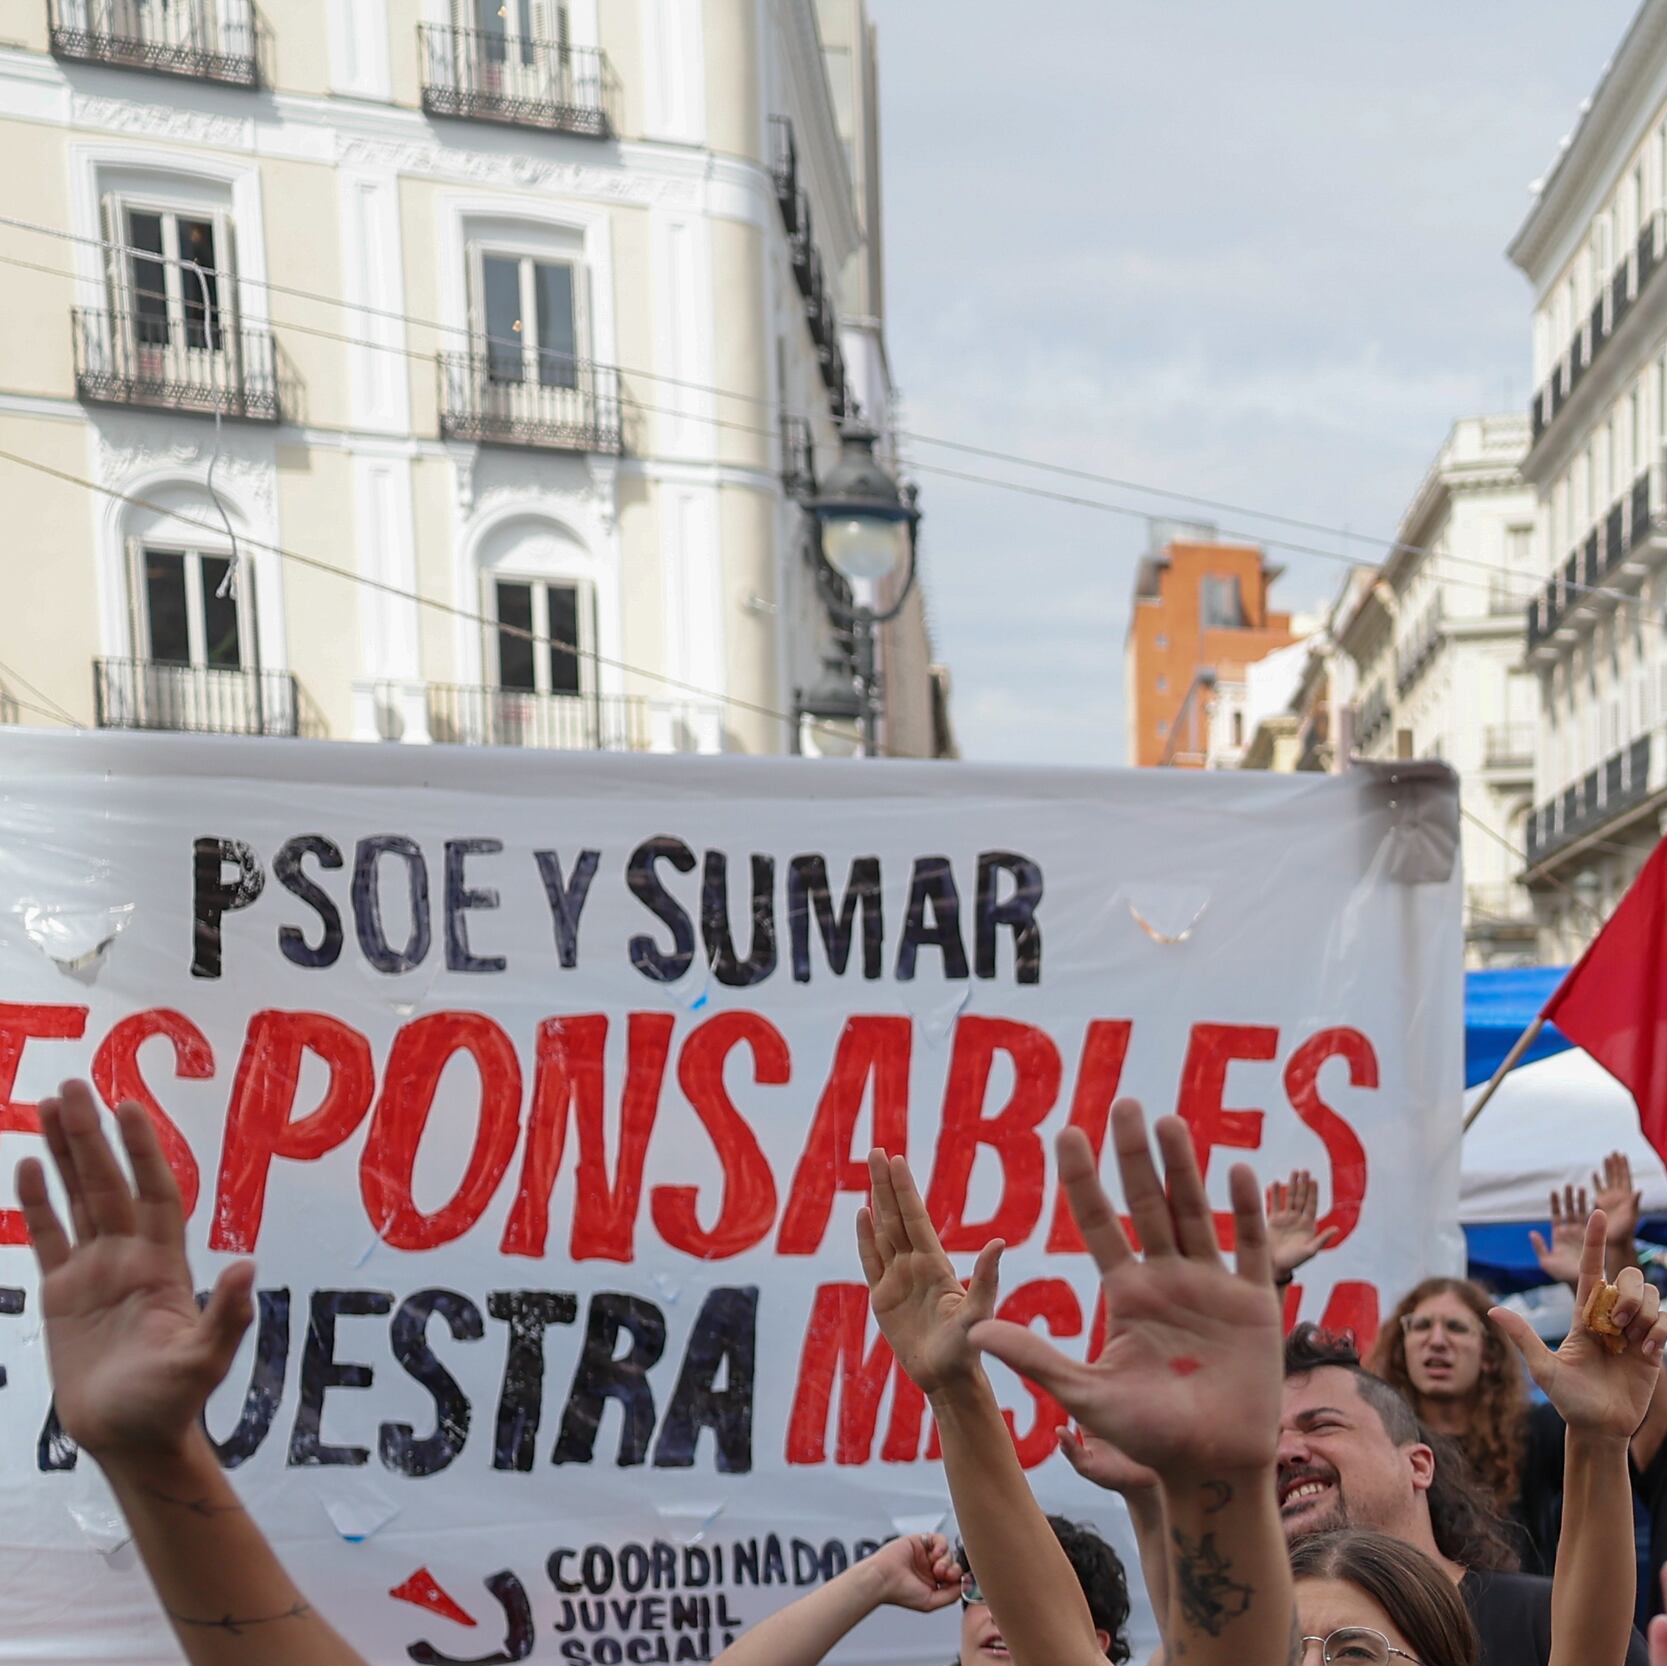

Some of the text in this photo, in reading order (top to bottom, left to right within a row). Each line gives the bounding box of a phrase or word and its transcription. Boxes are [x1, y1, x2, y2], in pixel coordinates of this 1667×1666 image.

[190, 836, 1044, 985] PSOE Y SUMAR
[546, 1532, 902, 1594] COORDINADO
[554, 1592, 742, 1634] JUVENIL
